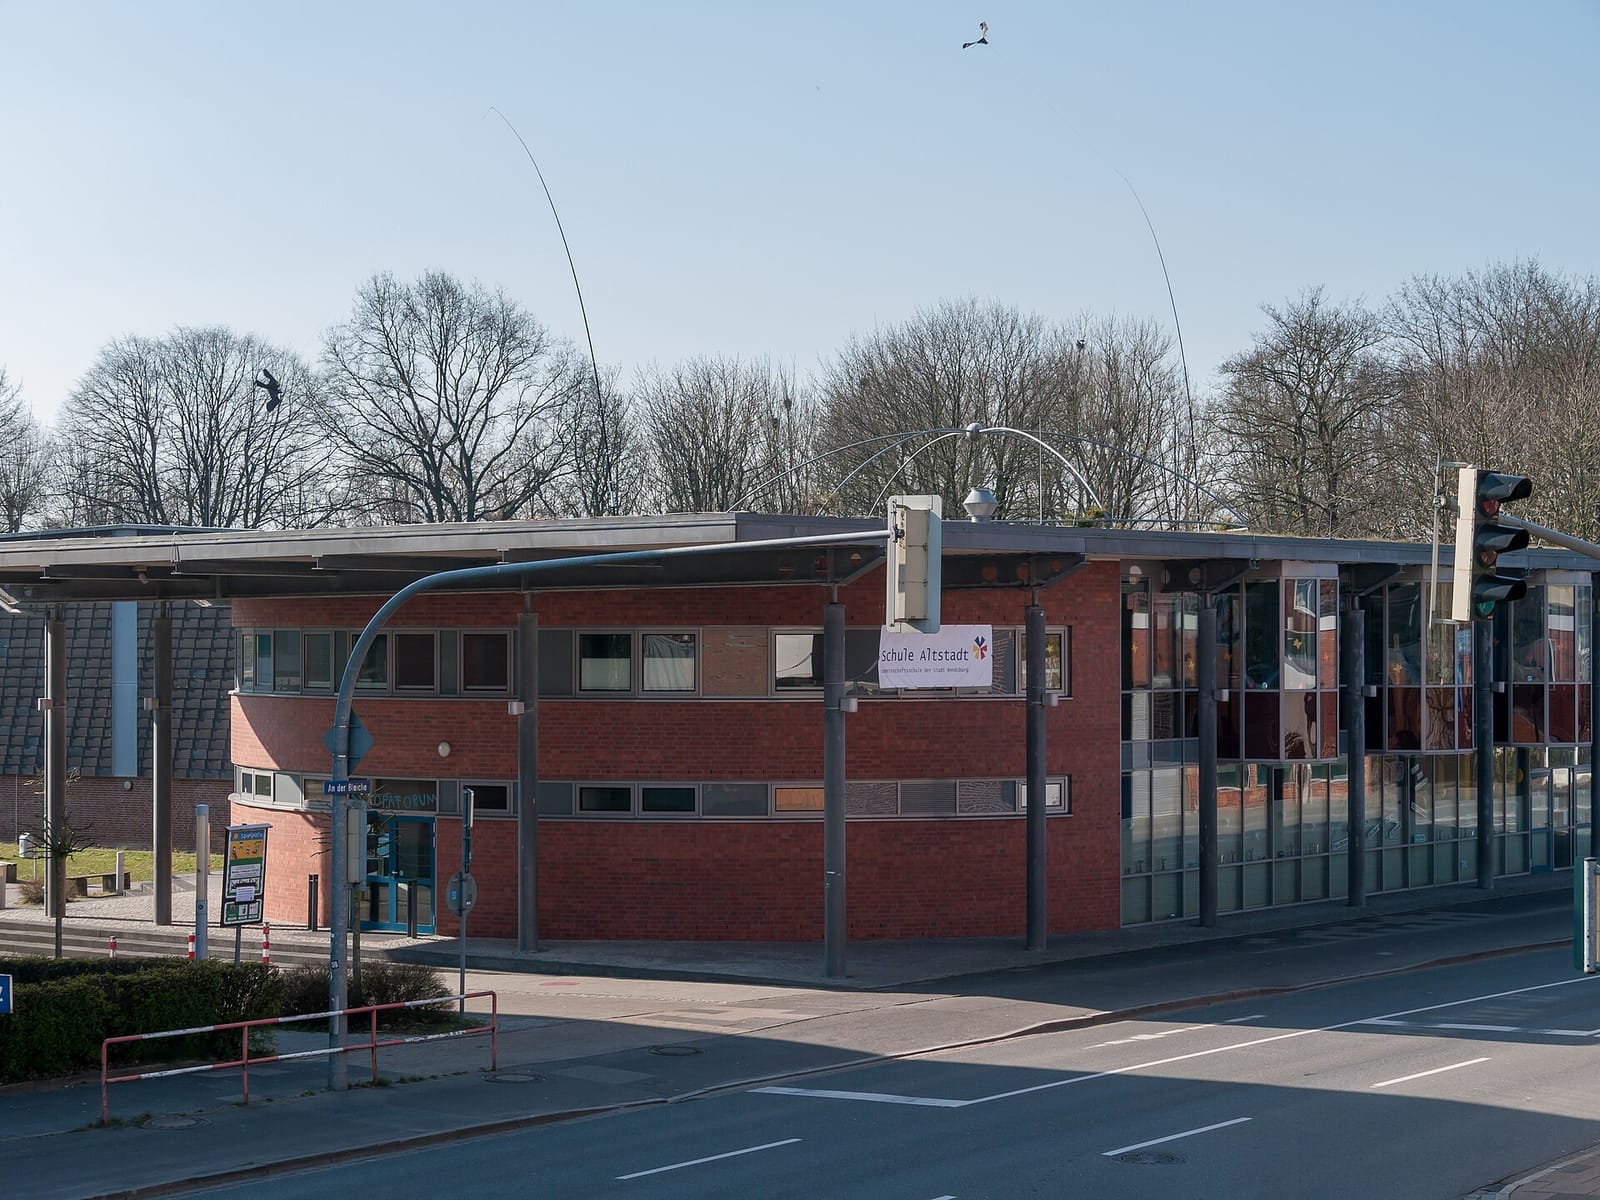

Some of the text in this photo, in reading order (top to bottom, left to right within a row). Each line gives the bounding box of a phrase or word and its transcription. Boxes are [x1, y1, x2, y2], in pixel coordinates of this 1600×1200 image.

[881, 648, 969, 661] Schule Altstadt
[327, 782, 368, 793] An der Bleiche
